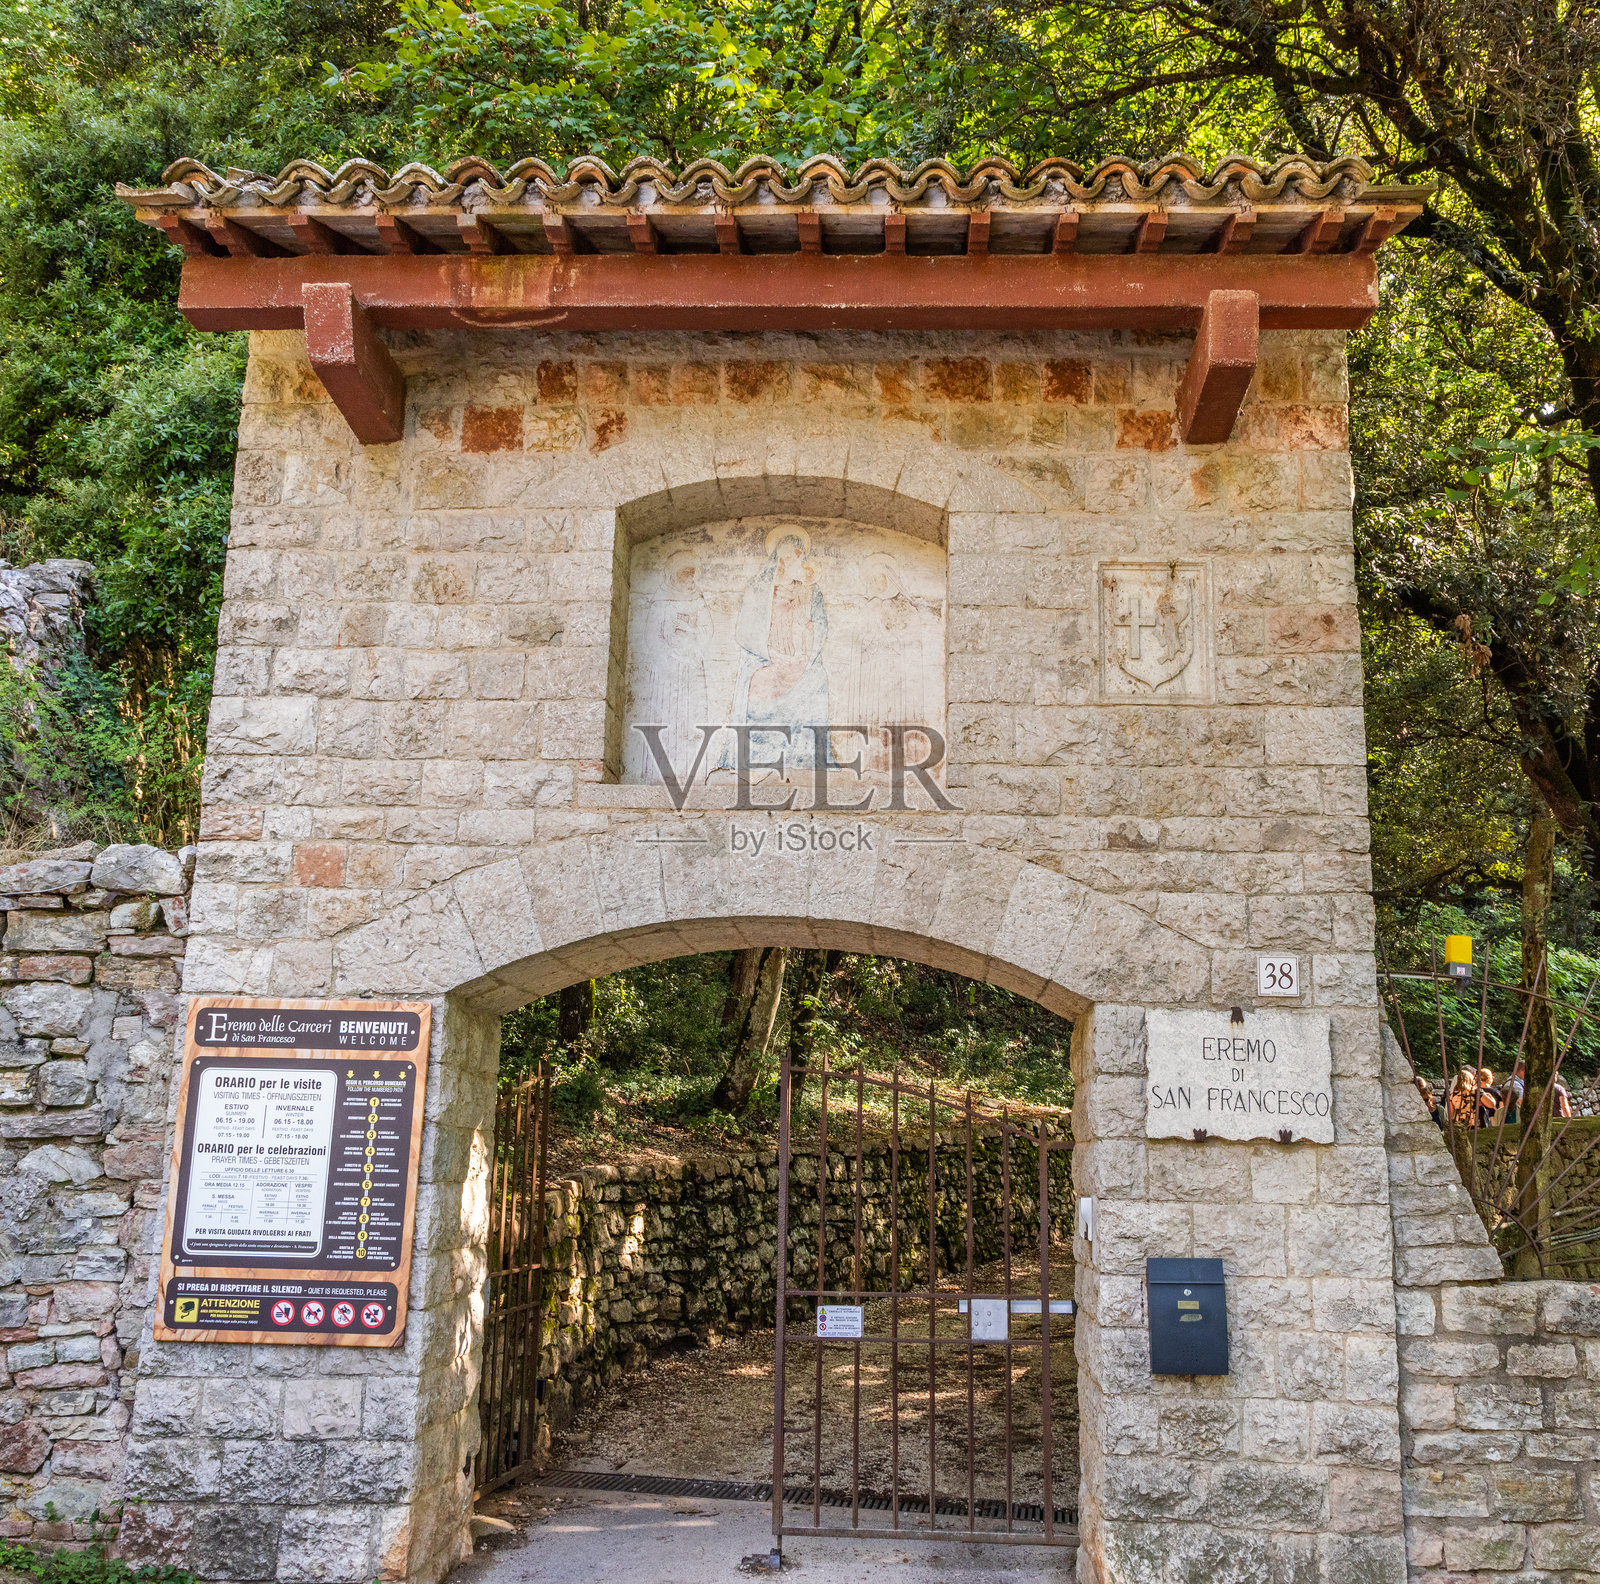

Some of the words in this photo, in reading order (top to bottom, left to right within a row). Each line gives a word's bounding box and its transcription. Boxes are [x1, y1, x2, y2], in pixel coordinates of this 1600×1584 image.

[1264, 962, 1294, 990] 38
[205, 1013, 256, 1042] Eremo
[258, 1015, 284, 1033] delle
[287, 1019, 332, 1034] Carceri
[339, 1021, 408, 1034] BENVENUTI
[232, 1033, 240, 1042] di
[241, 1034, 255, 1043] San
[258, 1034, 296, 1043] Francesco
[339, 1035, 407, 1046] WELCOME
[1202, 1037, 1276, 1063] EREMO
[1232, 1068, 1244, 1082] DI
[215, 1077, 256, 1088] ORARIO
[259, 1079, 277, 1090] per
[280, 1078, 290, 1089] le
[293, 1079, 322, 1090] visite
[213, 1092, 239, 1100] VISITING
[241, 1092, 260, 1100] TIMES
[1151, 1085, 1191, 1109] SAN
[1207, 1087, 1329, 1117] FRANCESCO
[197, 1143, 234, 1154] ORARIO
[237, 1145, 253, 1156] per
[256, 1144, 265, 1155] le
[267, 1145, 327, 1156] celebrazioni
[212, 1156, 236, 1164] PRAYER
[239, 1156, 258, 1164] TIMES
[264, 1157, 310, 1165] GEBETSZEITEN
[177, 1282, 185, 1291] SI
[186, 1283, 209, 1291] PREGA
[211, 1283, 218, 1292] DI
[220, 1284, 261, 1293] RISPETTARE
[263, 1285, 270, 1293] IL
[271, 1285, 302, 1294] SILENZIO
[308, 1287, 324, 1295] QUIET
[366, 1289, 387, 1297] PLEASE
[201, 1298, 260, 1308] ATTENZIONE
